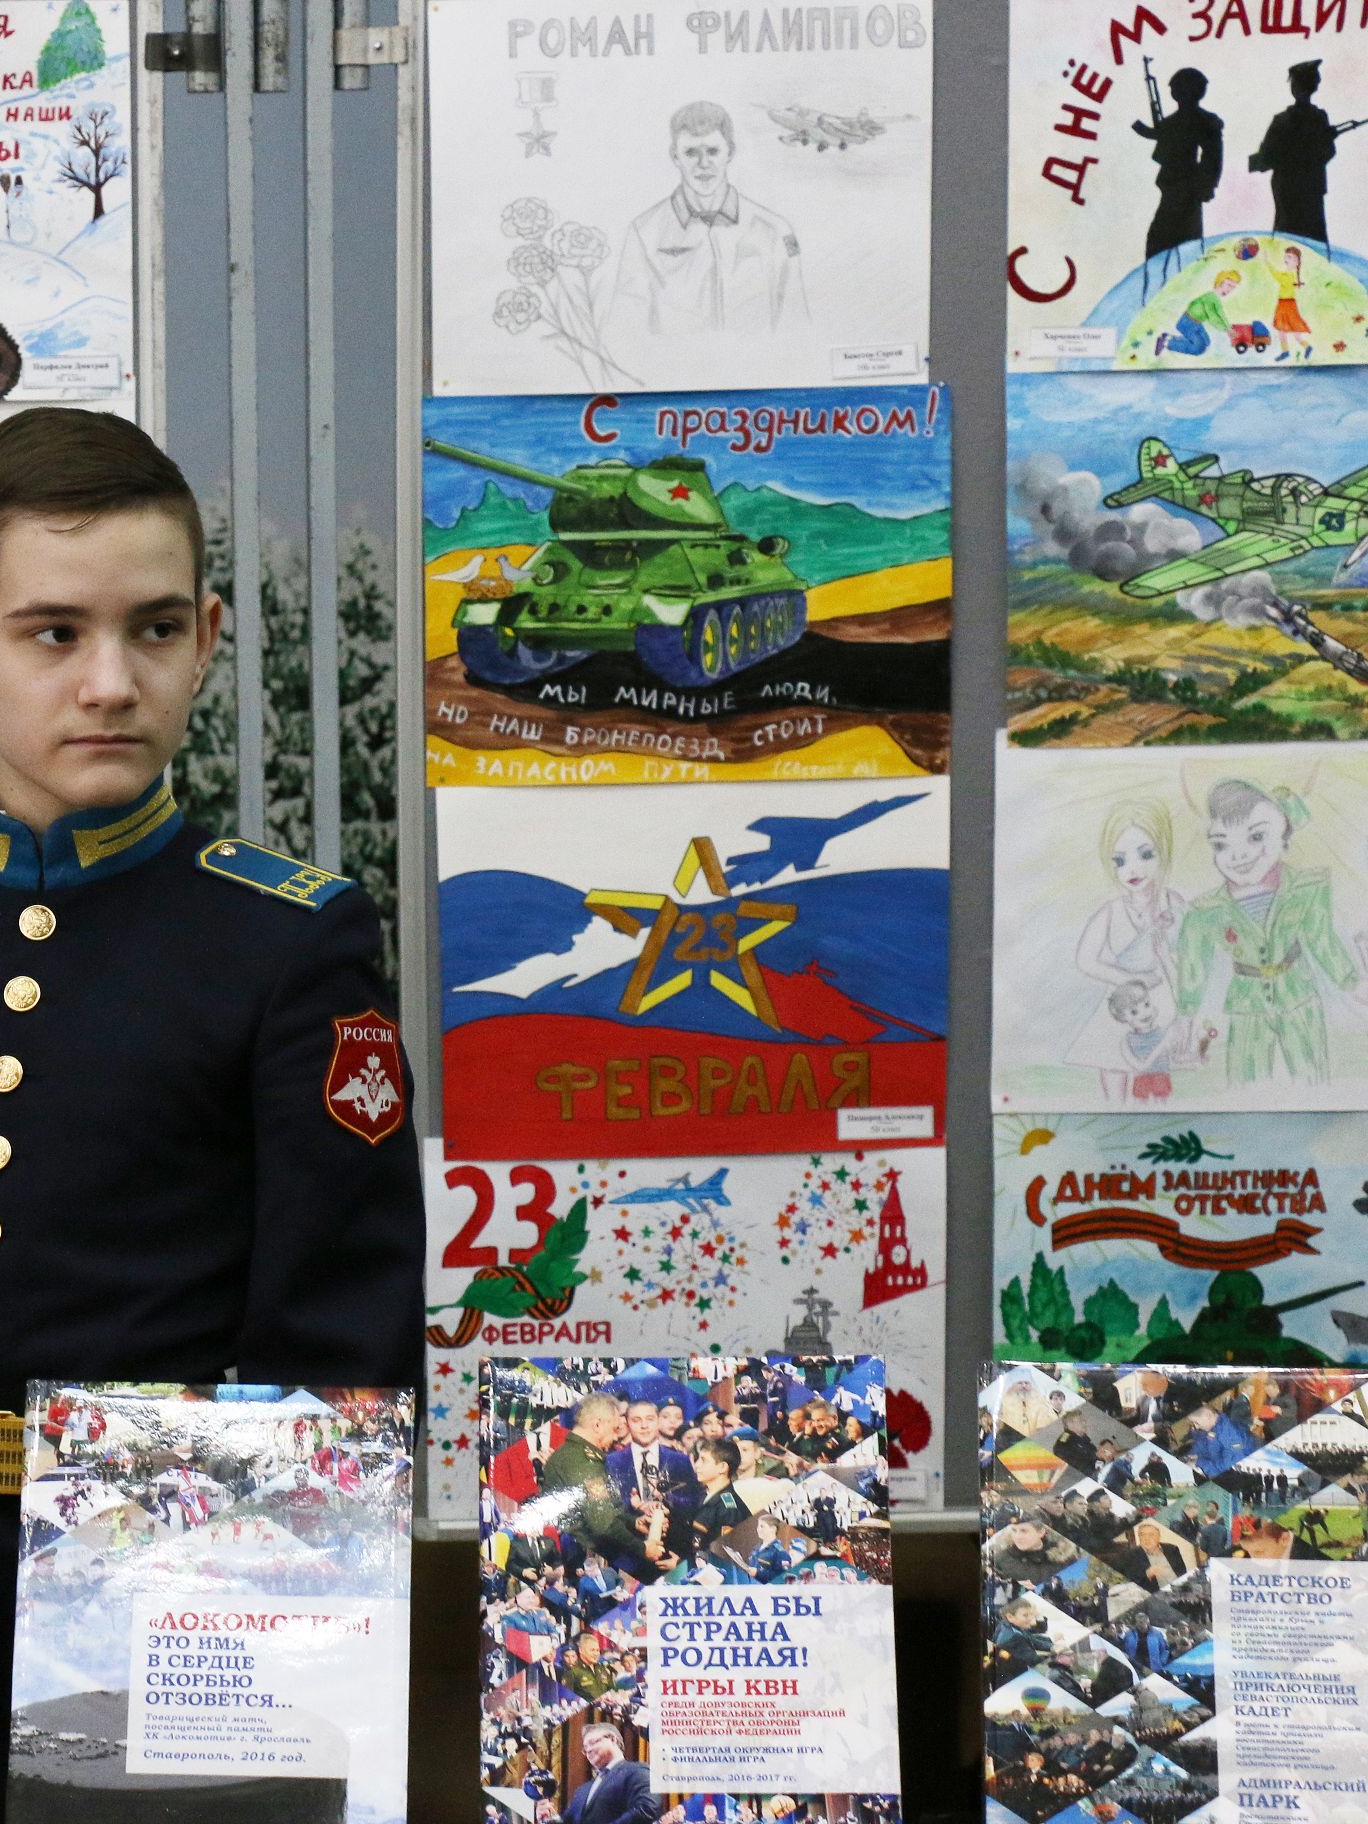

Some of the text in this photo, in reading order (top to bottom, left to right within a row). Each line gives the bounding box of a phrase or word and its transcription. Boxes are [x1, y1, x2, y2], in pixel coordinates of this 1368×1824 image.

[507, 3, 926, 58] РОМАН ФИЛИППОВ
[1007, 245, 1077, 303] С
[581, 387, 939, 453] С праздником!
[539, 684, 587, 703] МЫ
[614, 686, 736, 717] МИРНЫЕ
[437, 700, 827, 761] НО НАШ БРОНЕПОЕЗД СТОИТ
[474, 756, 617, 781] ЗАПАСНОМ
[644, 761, 710, 780] ПУТИ
[673, 912, 737, 963] 23
[342, 1024, 394, 1044] РОССИЯ
[536, 1050, 871, 1121] ФЕВРАЛЯ
[1051, 1163, 1157, 1206] ДНЁМ
[1162, 1168, 1320, 1192] ЗАЩИТНИКА
[1174, 1191, 1327, 1217] ОТЕЧЕСТВА
[442, 1164, 557, 1269] 23
[480, 1319, 613, 1346] ФЕВРАЛЯ
[1230, 1574, 1352, 1589] КАДЕТСКОЕ
[658, 1596, 822, 1617] ЖИЛА БЫ
[1230, 1591, 1332, 1605] БРАТСТВО
[660, 1621, 791, 1642] СТРАНА
[148, 1635, 246, 1650] ЭТО ИМЯ
[147, 1654, 255, 1671] В СЕРДЦЕ
[660, 1646, 809, 1671] РОДНАЯ!
[146, 1672, 253, 1688] СКОРБЬЮ
[1233, 1670, 1341, 1682] УВЛЕКАТЕЛЬНЫЕ
[661, 1679, 799, 1696] ИГРЫ КВН
[1233, 1681, 1356, 1696] ПРИКЛЮЧЕНИЯ
[145, 1690, 292, 1708] ОТЗОВЁТСЯ...
[660, 1701, 776, 1709] СРЕДИ ДОВУЗОВСКИХ
[1234, 1694, 1359, 1706] СЕВАСТОПОЛЬСКИХ
[660, 1708, 846, 1719] ОБРАЗОВАТЕЛЬНЫХ ОРГАНИЗАЦИЙ
[1234, 1705, 1292, 1718] КАДЕТ
[661, 1719, 800, 1727] МИНИСТЕРСТВА ОБОРОНЫ
[661, 1727, 801, 1737] РОССИЙСКОЙ ФЕДЕРАЦИИ
[143, 1749, 234, 1762] Ставрополь,
[240, 1751, 276, 1762] 2016
[671, 1756, 765, 1764] ФИНАЛЬНАЯ ИГРА
[1237, 1777, 1367, 1793] АДМИРАЛЬСКИЙ
[1238, 1793, 1301, 1810] ПАРК
